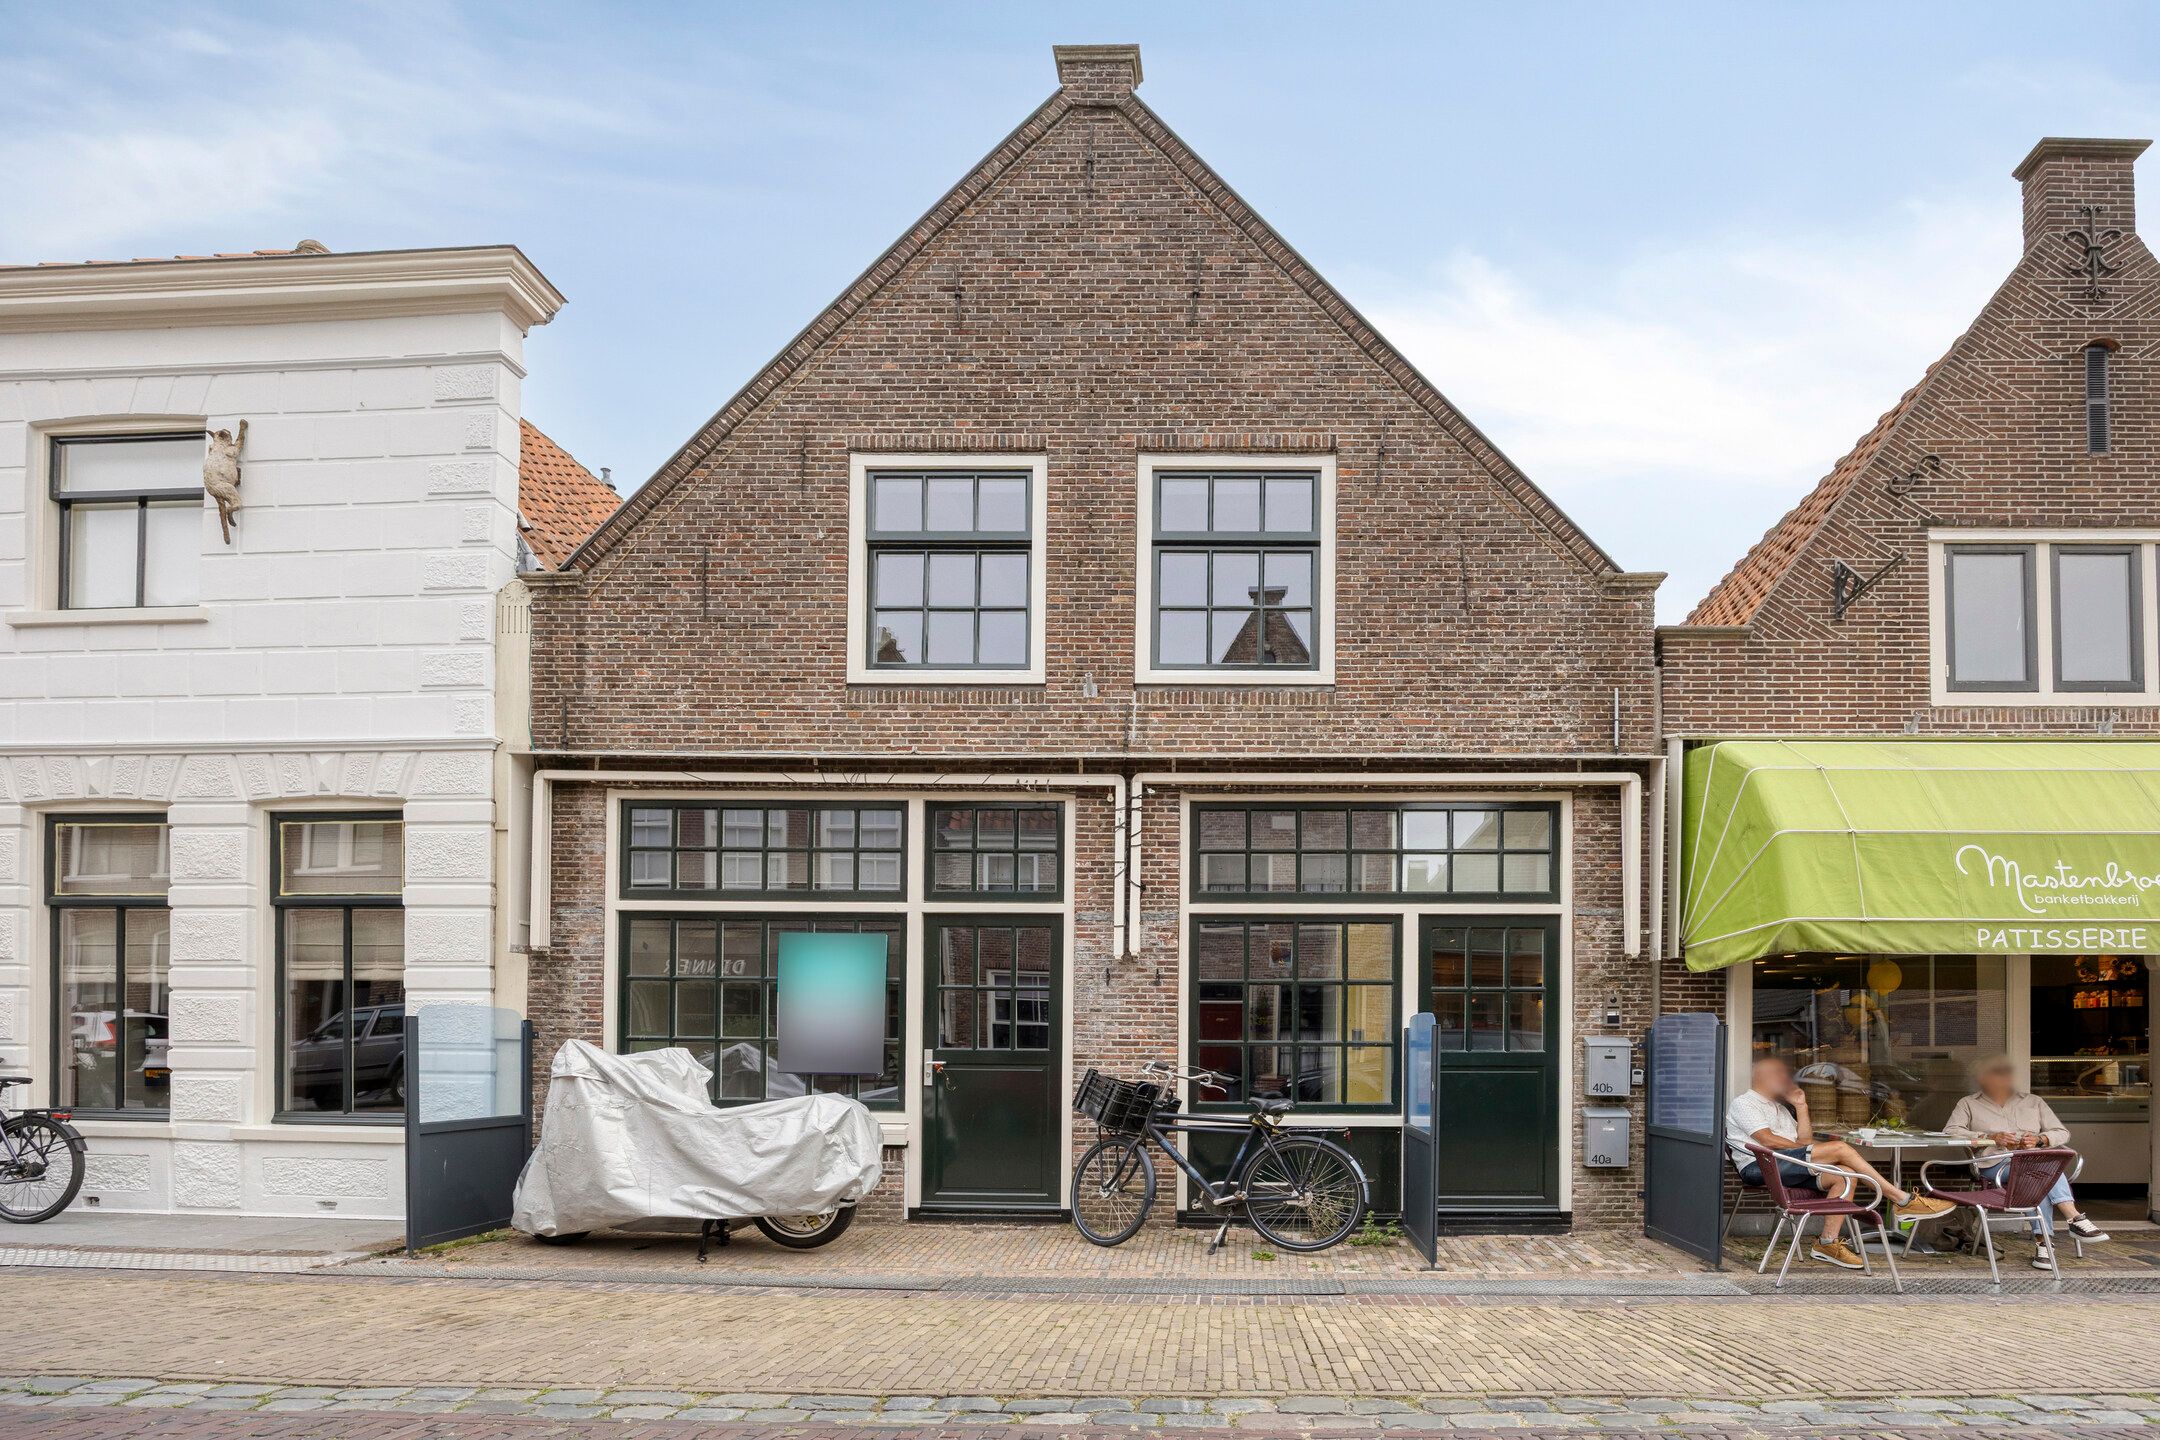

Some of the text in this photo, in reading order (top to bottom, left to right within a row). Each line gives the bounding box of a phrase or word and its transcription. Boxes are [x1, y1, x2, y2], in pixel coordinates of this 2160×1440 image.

[2034, 894, 2140, 907] banketbakkerij
[1976, 928, 2147, 949] PATISSERIE
[1592, 1083, 1613, 1093] 40b
[1591, 1154, 1612, 1165] 40a
